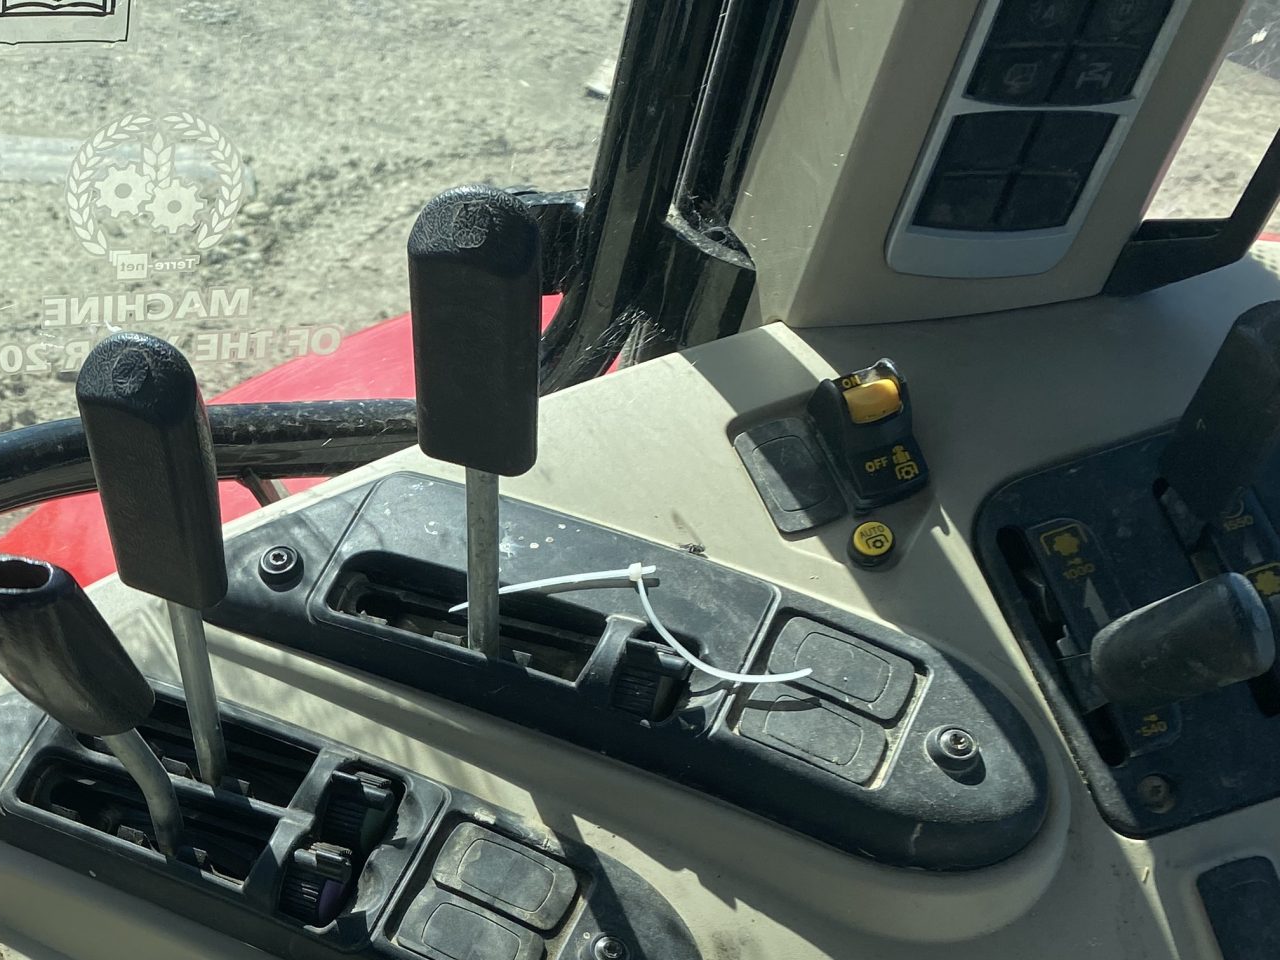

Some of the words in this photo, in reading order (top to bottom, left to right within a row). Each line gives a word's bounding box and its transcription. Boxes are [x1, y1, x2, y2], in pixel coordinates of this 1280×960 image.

[842, 375, 861, 389] ON
[865, 456, 889, 473] OFF
[860, 525, 885, 539] AUTO
